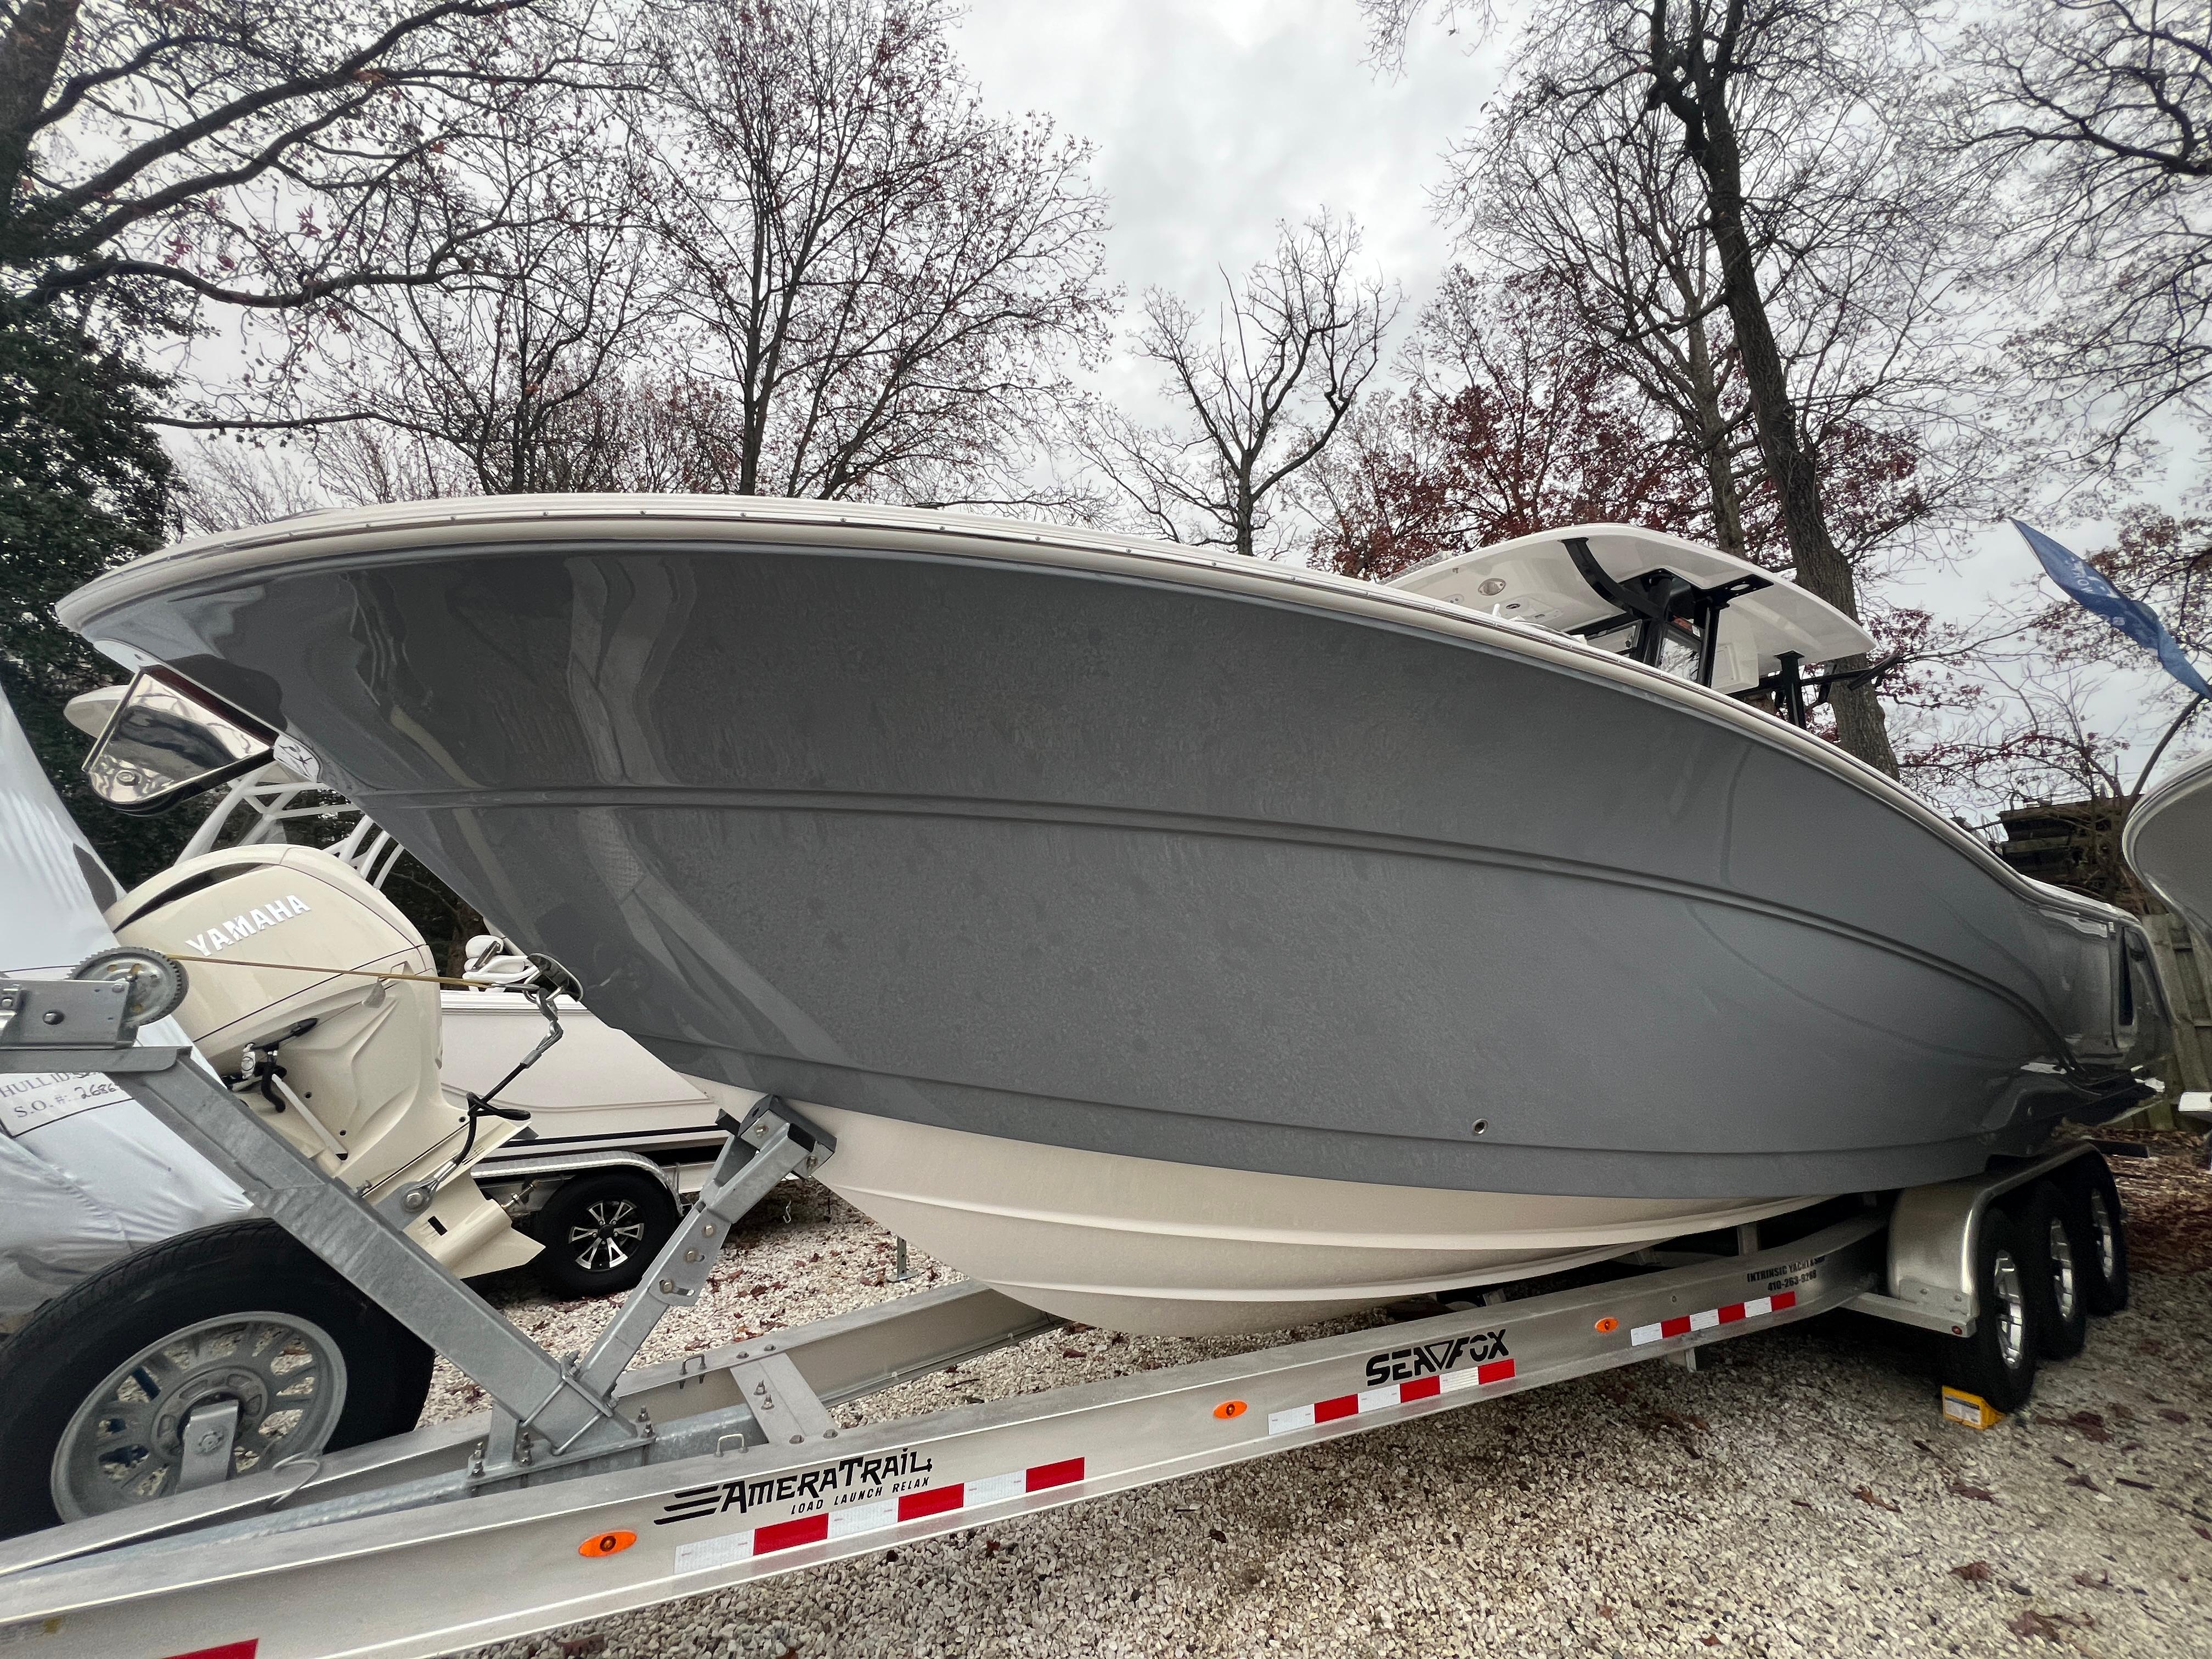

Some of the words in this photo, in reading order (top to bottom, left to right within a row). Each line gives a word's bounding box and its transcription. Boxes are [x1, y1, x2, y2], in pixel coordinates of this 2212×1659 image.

[185, 895, 312, 957] YAMAHA
[0, 1077, 52, 1097] HULL
[14, 1100, 54, 1118] S.O.
[1747, 1265, 1787, 1282] INTRINSIC
[791, 1500, 823, 1515] LOAD
[833, 1487, 882, 1506] LAUNCH
[892, 1476, 930, 1493] RELAX
